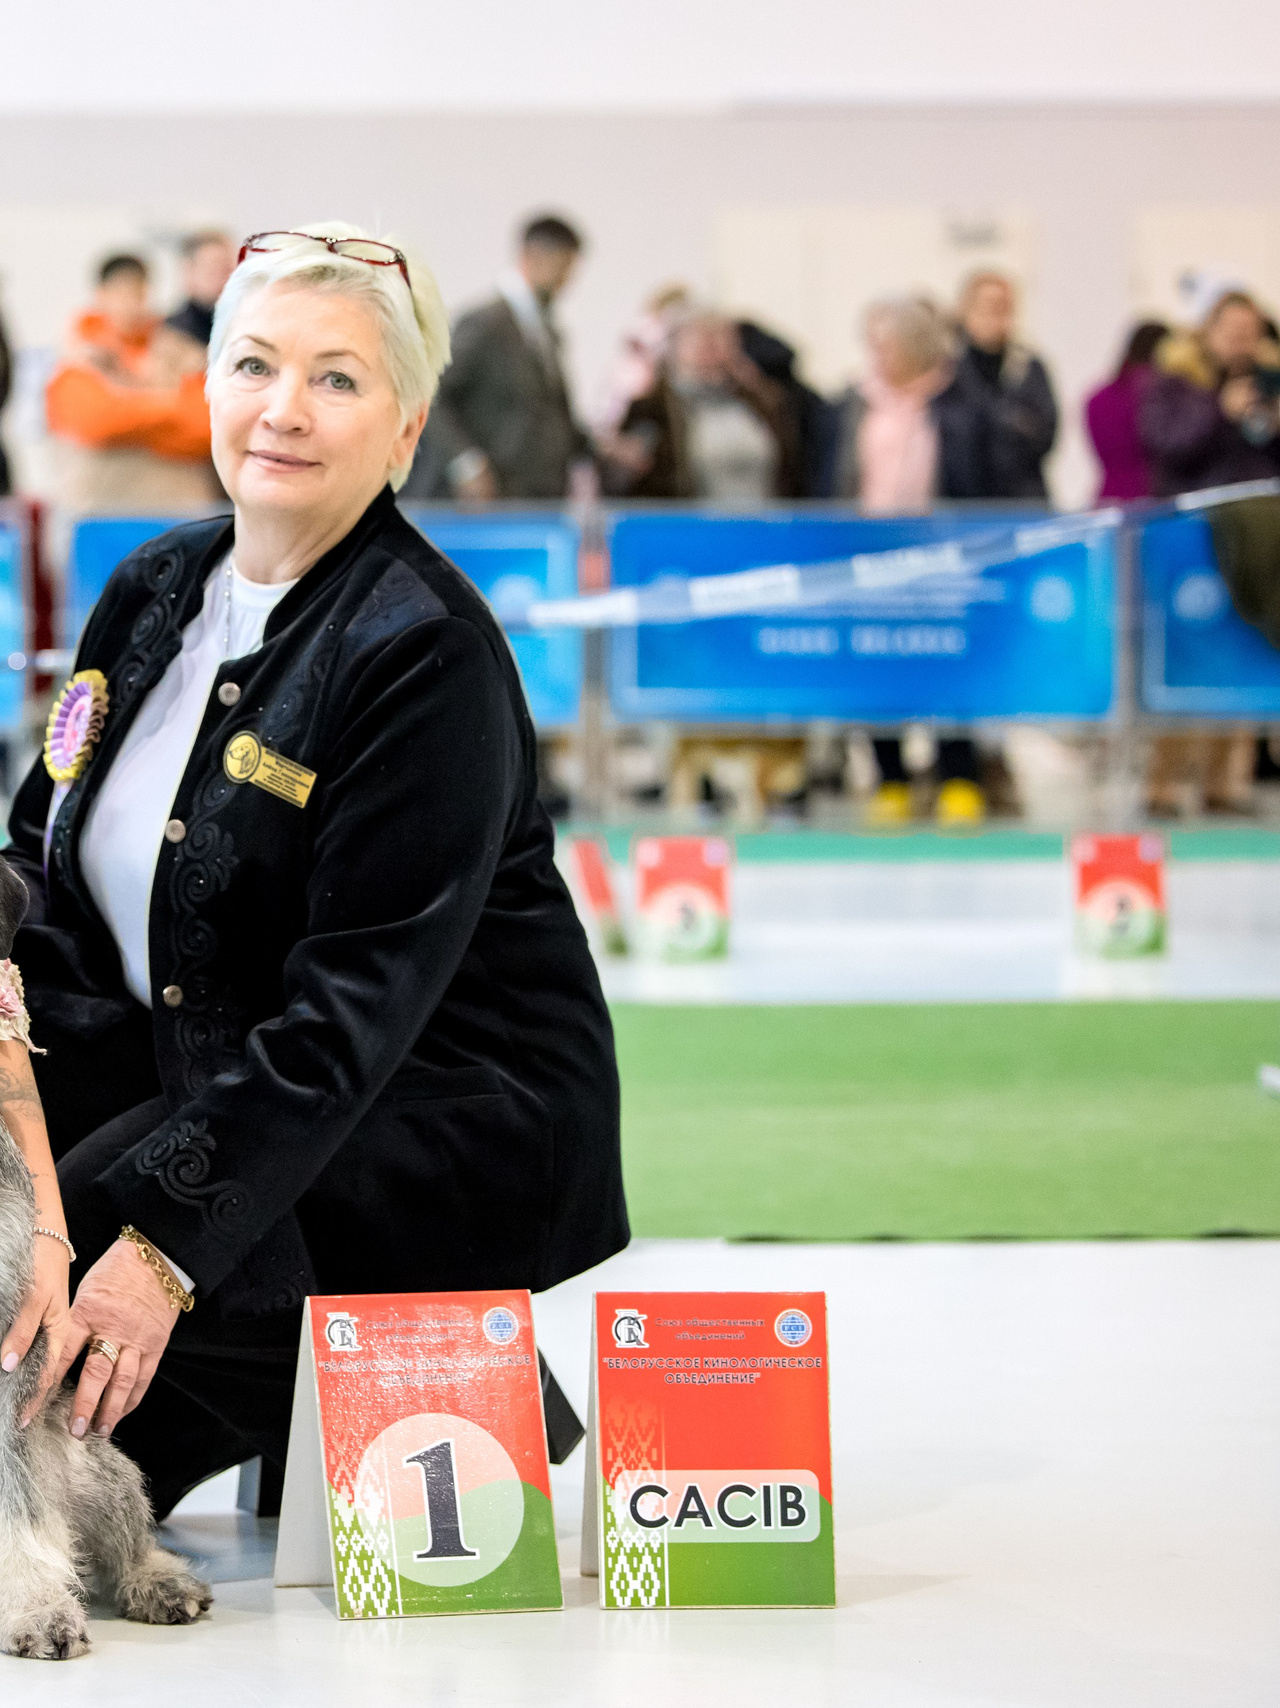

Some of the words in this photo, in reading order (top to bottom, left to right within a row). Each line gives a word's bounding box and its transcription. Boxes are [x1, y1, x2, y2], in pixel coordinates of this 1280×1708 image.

[655, 1318, 682, 1328] Союз
[685, 1318, 765, 1329] общественных
[675, 1331, 745, 1341] объединений
[603, 1357, 700, 1369] "БЕЛОРУССКОЕ
[704, 1356, 821, 1369] КИНОЛОГИЧЕСКОЕ
[664, 1373, 761, 1385] ОБЪЕДИНЕНИЕ"
[404, 1440, 478, 1560] 1
[629, 1484, 807, 1528] CACIB
